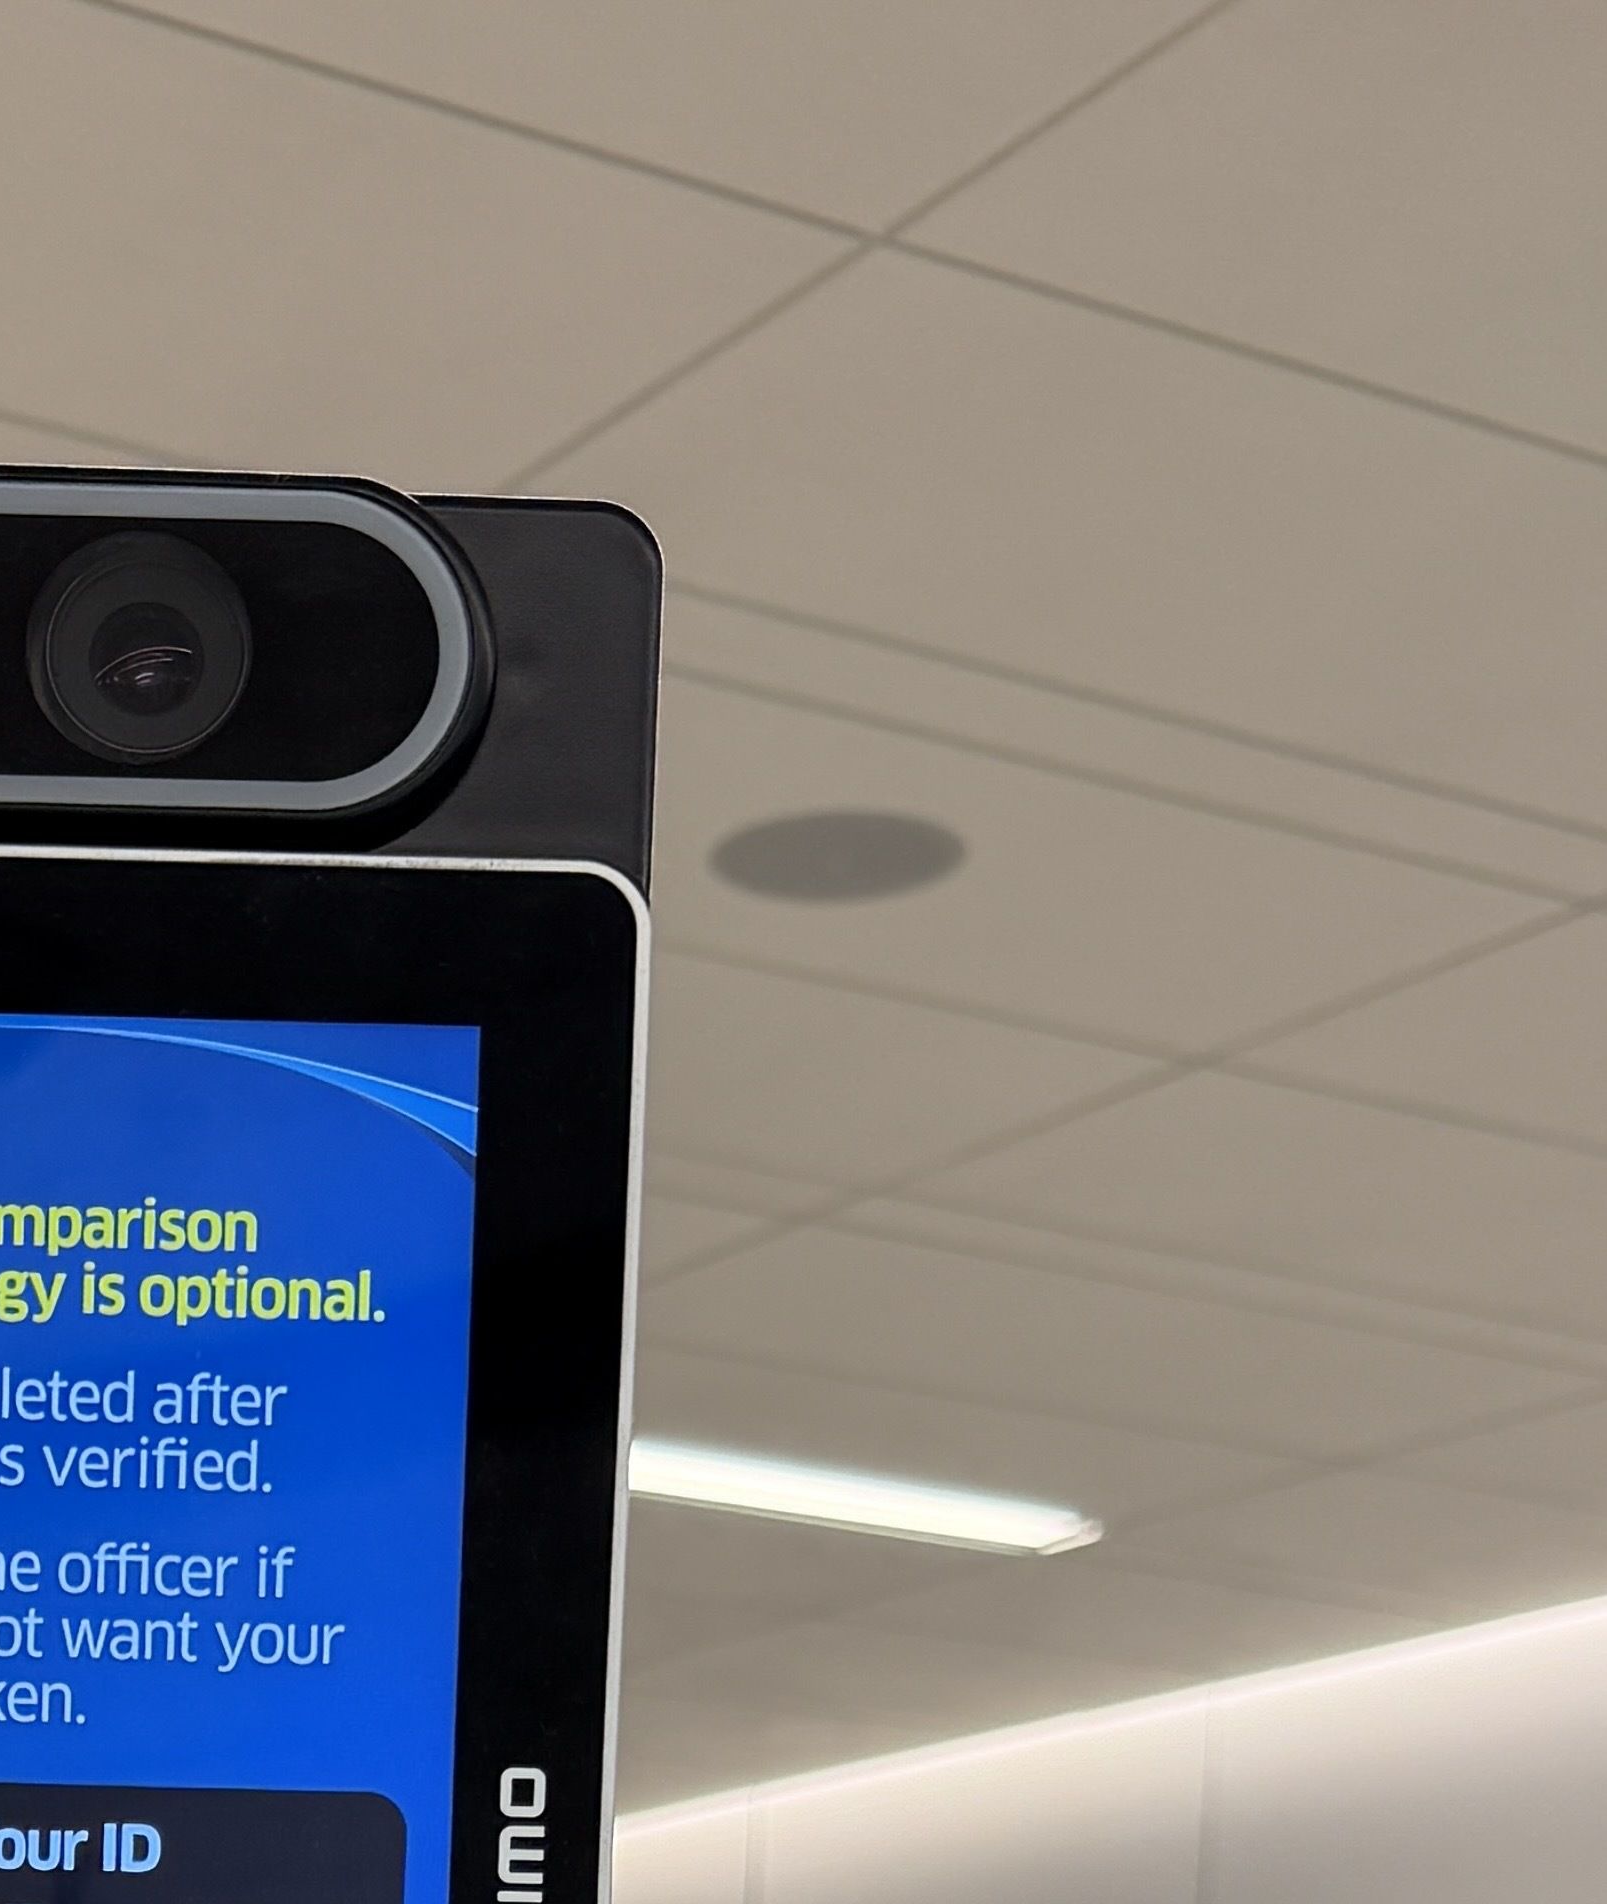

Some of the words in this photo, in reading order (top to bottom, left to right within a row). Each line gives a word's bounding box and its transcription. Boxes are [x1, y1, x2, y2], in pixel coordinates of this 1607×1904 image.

[82, 1260, 126, 1316] is
[139, 1264, 385, 1326] optional.
[153, 1371, 288, 1426] after
[42, 1435, 272, 1493] verified.
[58, 1541, 239, 1598] officer
[258, 1545, 296, 1598] if
[61, 1612, 199, 1663] want
[215, 1622, 346, 1673] your
[102, 1822, 162, 1873] ID
